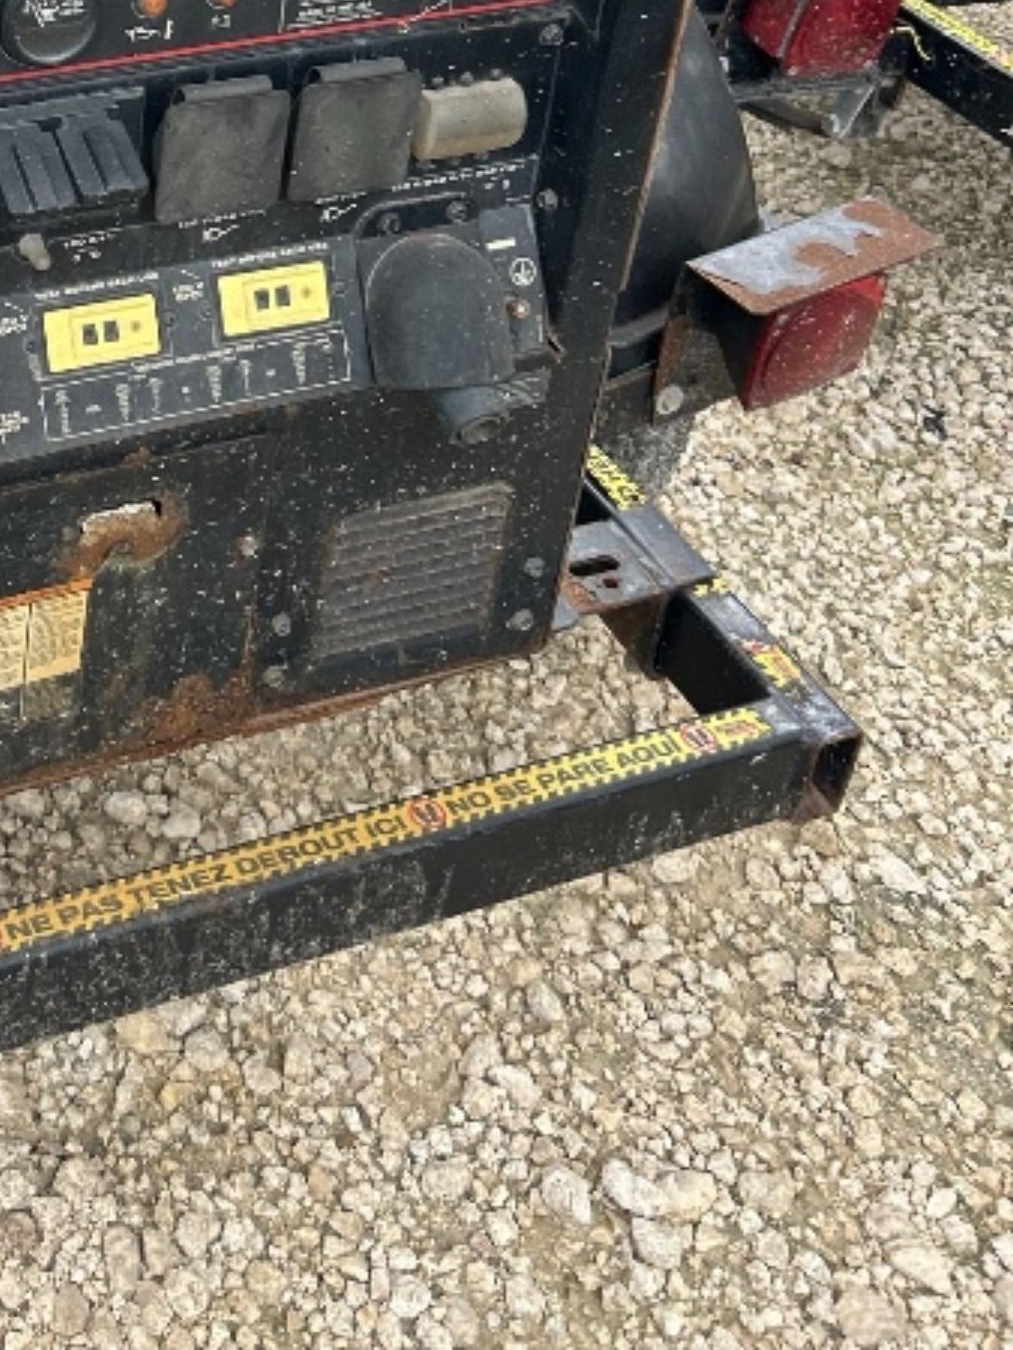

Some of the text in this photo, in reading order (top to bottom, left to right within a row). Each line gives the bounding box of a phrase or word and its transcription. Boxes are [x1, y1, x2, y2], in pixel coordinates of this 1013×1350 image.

[5, 914, 53, 940] NE
[58, 895, 123, 925] PAS
[126, 866, 232, 902] TENEZ
[237, 831, 363, 875] DEBOUT
[367, 815, 408, 838] ICI
[446, 790, 491, 814] NO
[495, 780, 530, 802] SE
[539, 755, 613, 791] PARE
